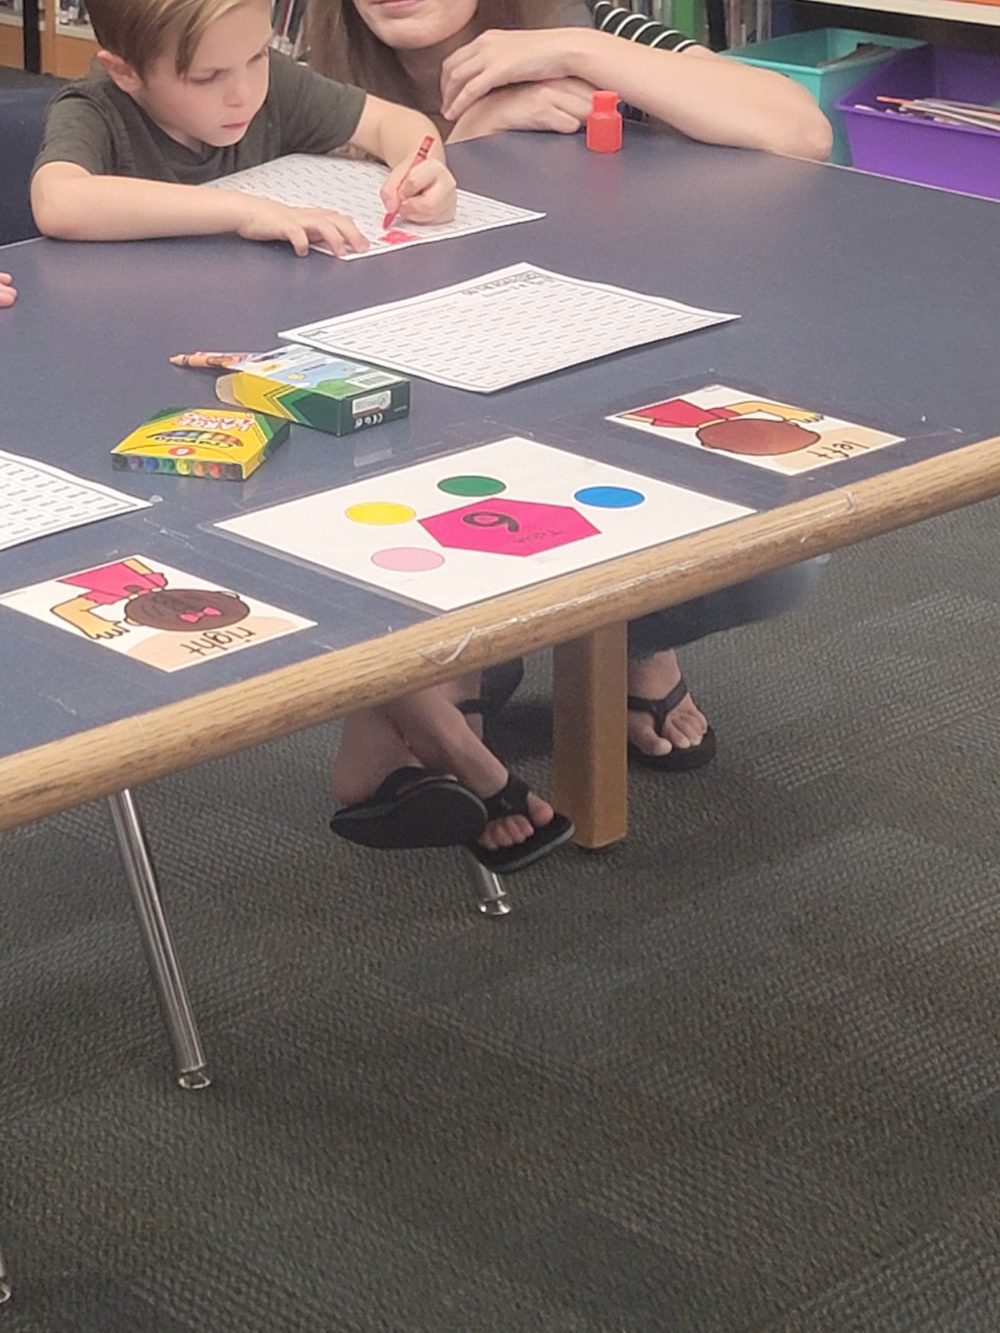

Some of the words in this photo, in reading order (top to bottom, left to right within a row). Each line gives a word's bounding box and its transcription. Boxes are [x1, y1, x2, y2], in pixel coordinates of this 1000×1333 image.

[152, 435, 234, 450] Crayola
[807, 440, 870, 460] left
[461, 510, 521, 534] 6
[180, 626, 257, 657] right
